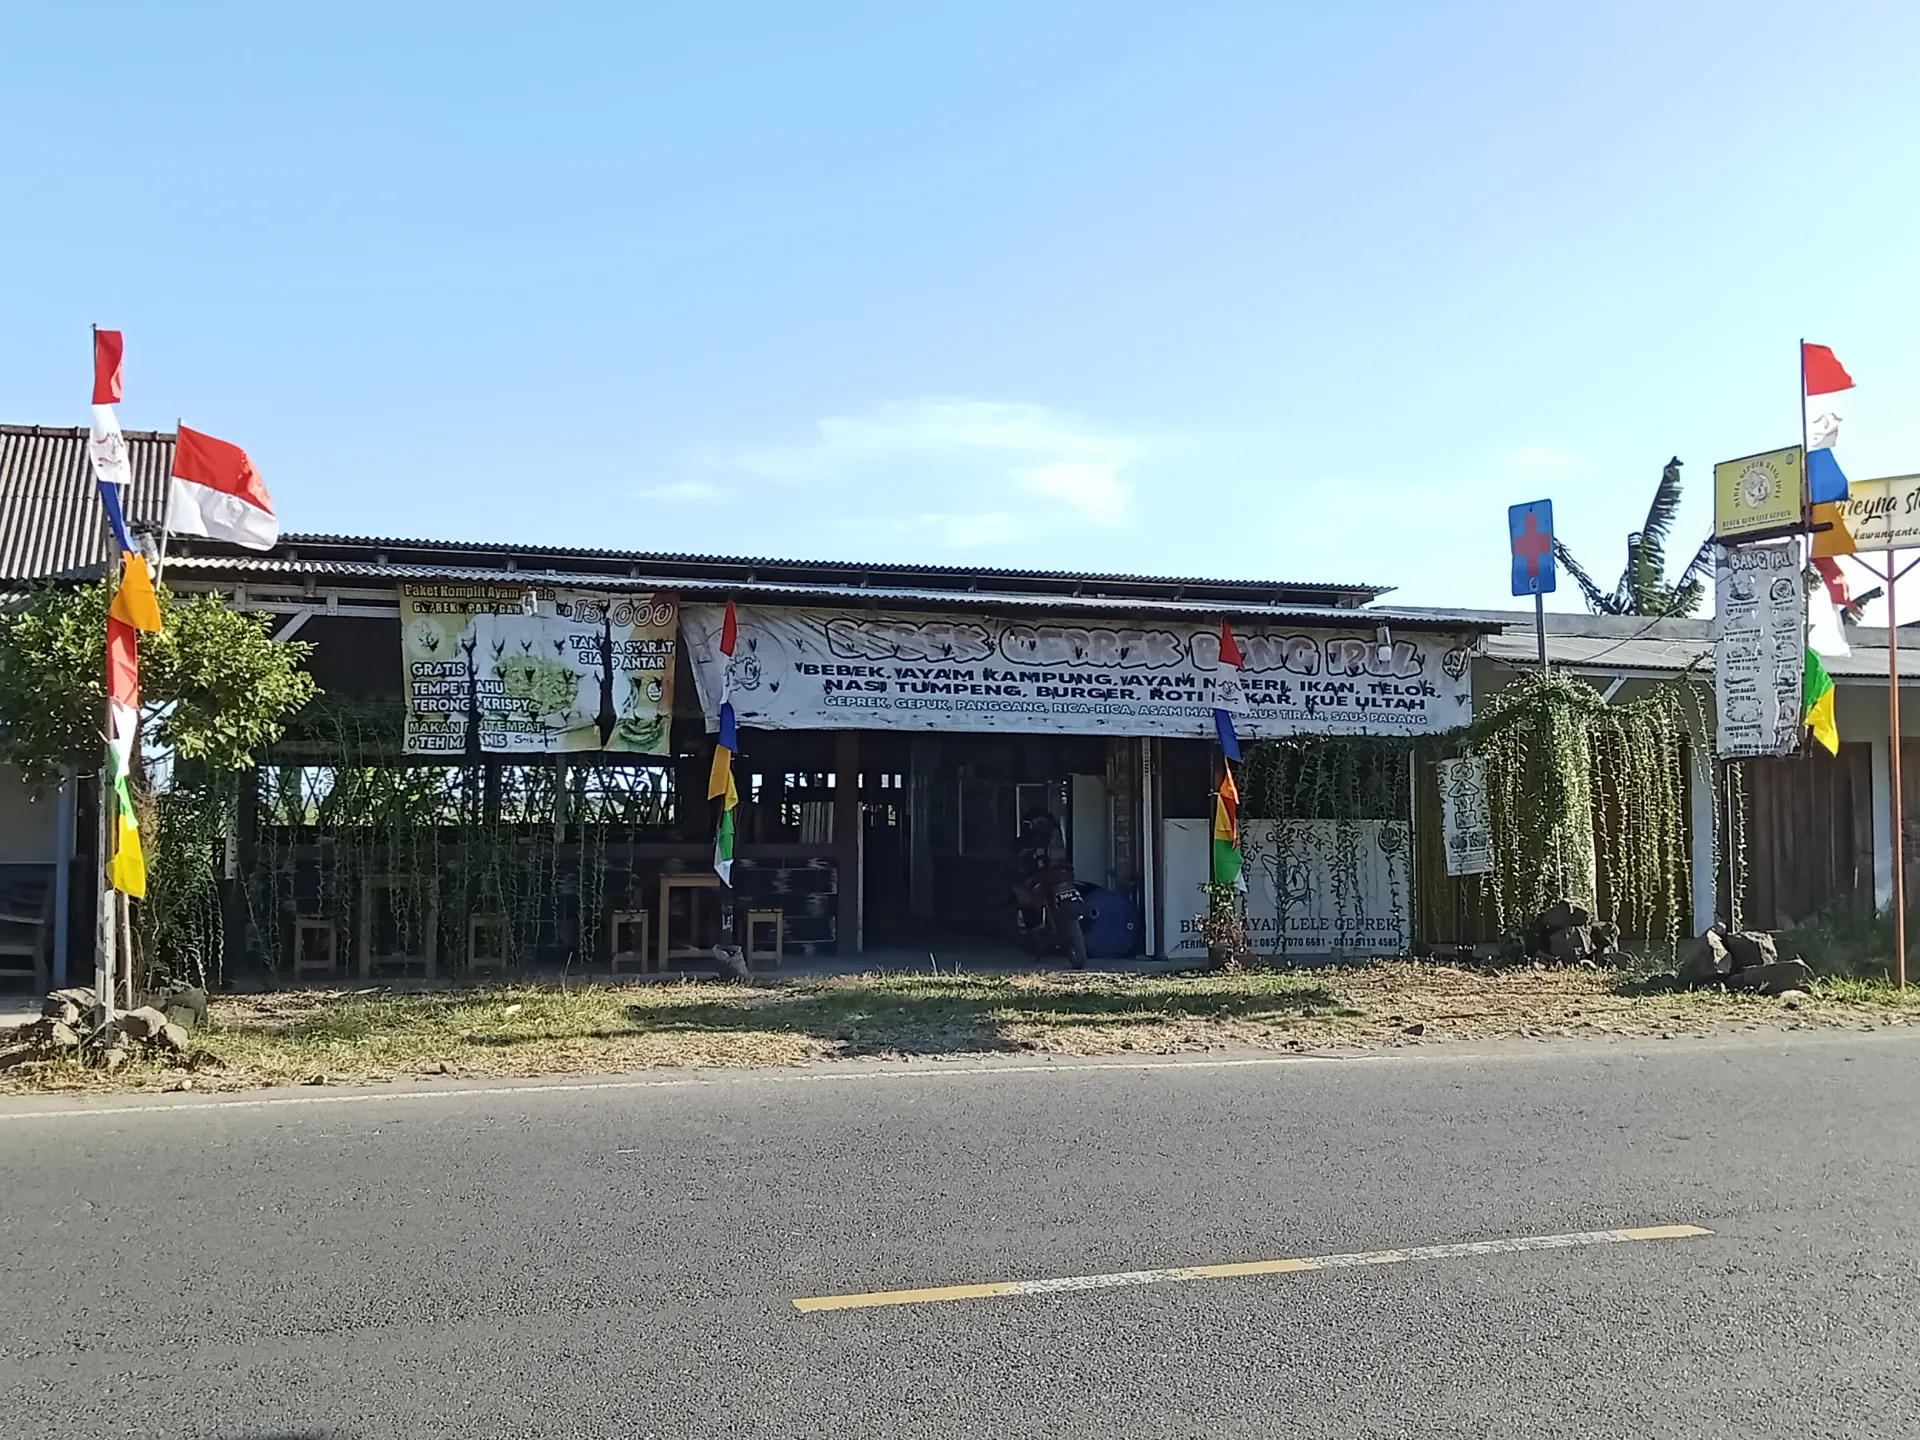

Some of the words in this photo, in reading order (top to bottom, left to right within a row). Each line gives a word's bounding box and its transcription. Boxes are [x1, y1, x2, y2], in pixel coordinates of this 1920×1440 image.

[1853, 527, 1920, 544] kawungante
[1730, 551, 1768, 570] BANG
[405, 584, 438, 597] Paket
[440, 585, 486, 599] Komplit
[487, 587, 519, 600] Ayam
[1189, 631, 1320, 675] BNG
[411, 662, 466, 677] GRATIS
[622, 656, 666, 670] ANTAR
[412, 681, 459, 696] TEMPE
[459, 680, 505, 696] TAHU
[803, 663, 892, 680] BEBEK,
[901, 667, 974, 681] AYAM
[983, 670, 1118, 686] KAMPUNG,
[1127, 674, 1195, 688] AYAM
[1203, 677, 1292, 692] NGERI,
[1300, 681, 1361, 695] IKAN,
[1368, 683, 1442, 698] TELOR,
[825, 679, 887, 692] NASI
[895, 681, 1028, 698] TUMPENG,
[1036, 686, 1142, 701] BURGER,
[1150, 689, 1204, 702] ROTI
[1211, 690, 1297, 706] KAR,
[1305, 694, 1348, 707] KUE
[1355, 697, 1426, 710] ULTAH
[482, 697, 530, 711] KRISPY
[824, 696, 892, 709] GEPREK,
[895, 698, 953, 710] GEPUK,
[956, 700, 1050, 713] PANGGANG,
[1052, 702, 1136, 716] RICA-RICA,
[1138, 704, 1183, 716] ASAM
[1281, 710, 1329, 722] TIRAM,
[1331, 711, 1367, 722] SAUS
[1370, 712, 1428, 724] PADANG
[409, 721, 460, 733] MAKAN
[418, 735, 445, 749] TEH
[1290, 917, 1330, 931] LELE
